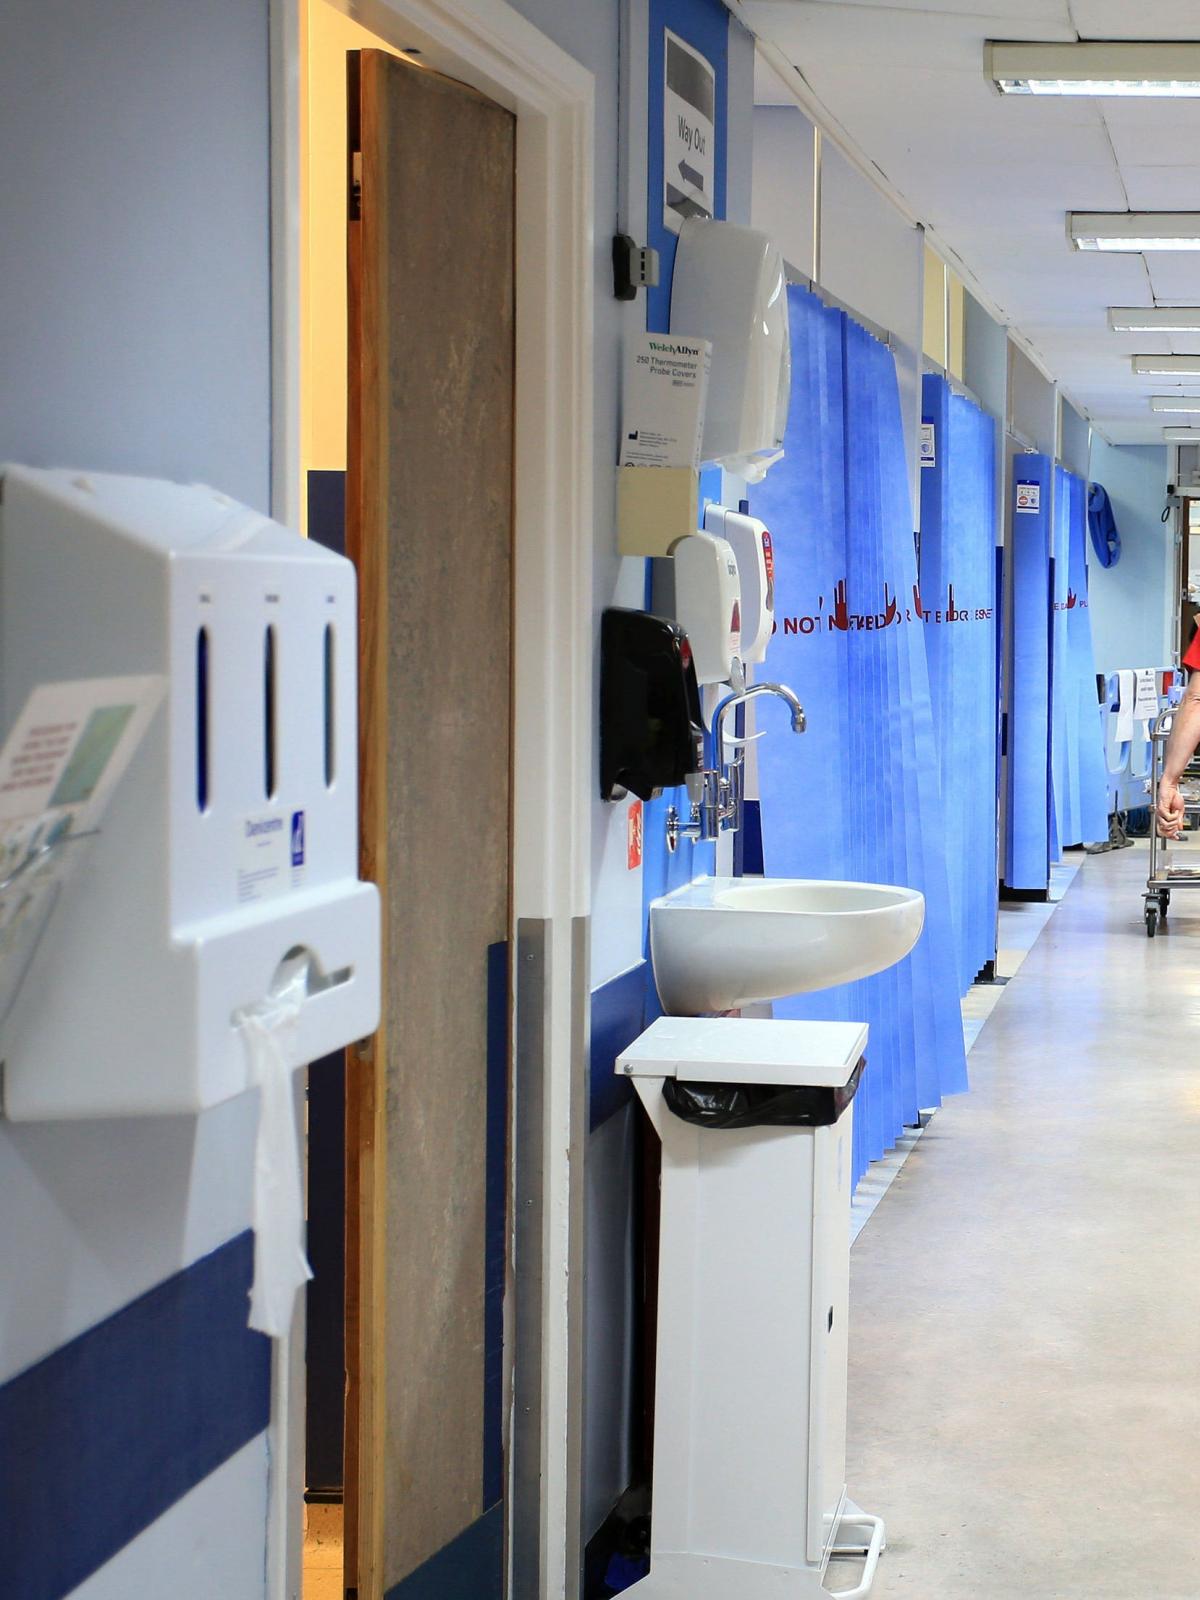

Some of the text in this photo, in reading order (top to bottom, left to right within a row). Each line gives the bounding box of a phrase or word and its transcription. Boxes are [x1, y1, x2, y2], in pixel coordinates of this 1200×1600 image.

[678, 115, 706, 156] Way Out
[651, 357, 697, 369] Thermometer
[650, 366, 697, 378] Probe Covers
